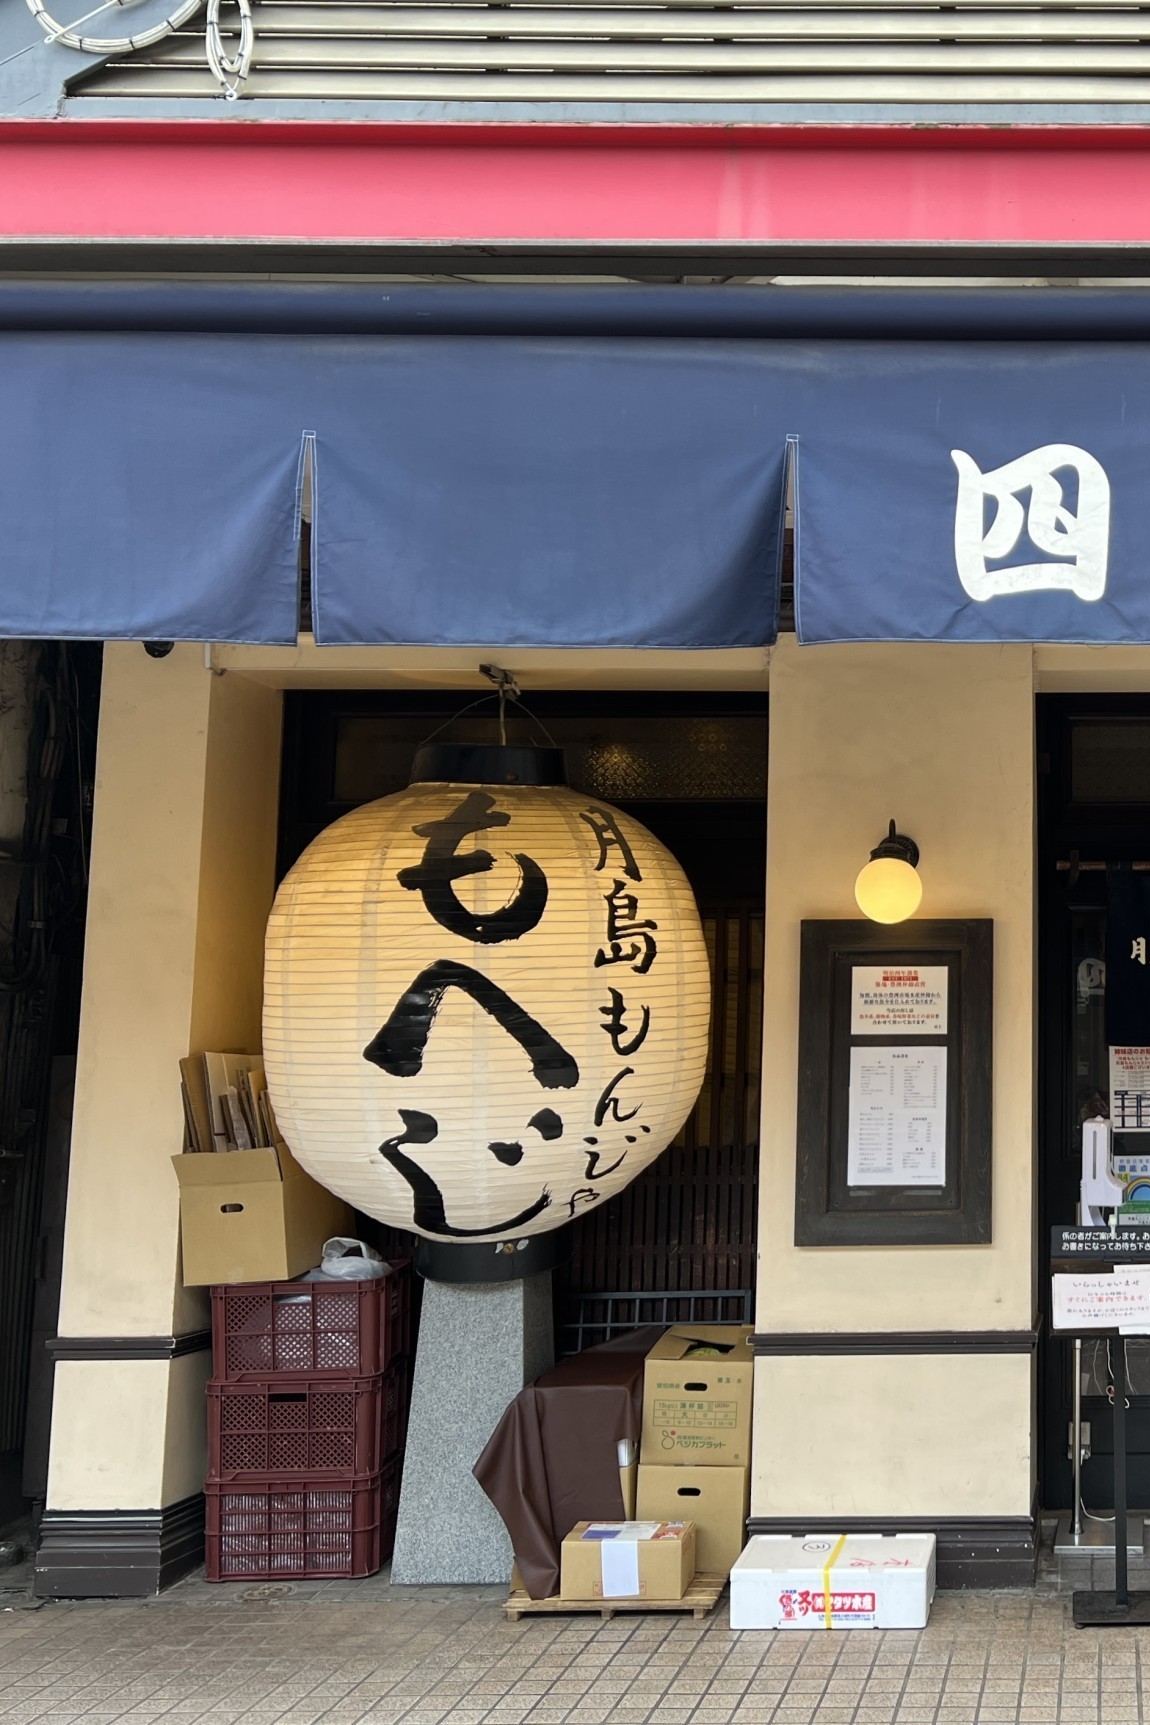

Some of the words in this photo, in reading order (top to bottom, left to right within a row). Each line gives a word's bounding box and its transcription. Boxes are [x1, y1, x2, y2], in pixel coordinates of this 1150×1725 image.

[363, 791, 579, 1236] もへじ
[568, 805, 658, 1218] 月島もんじゃ
